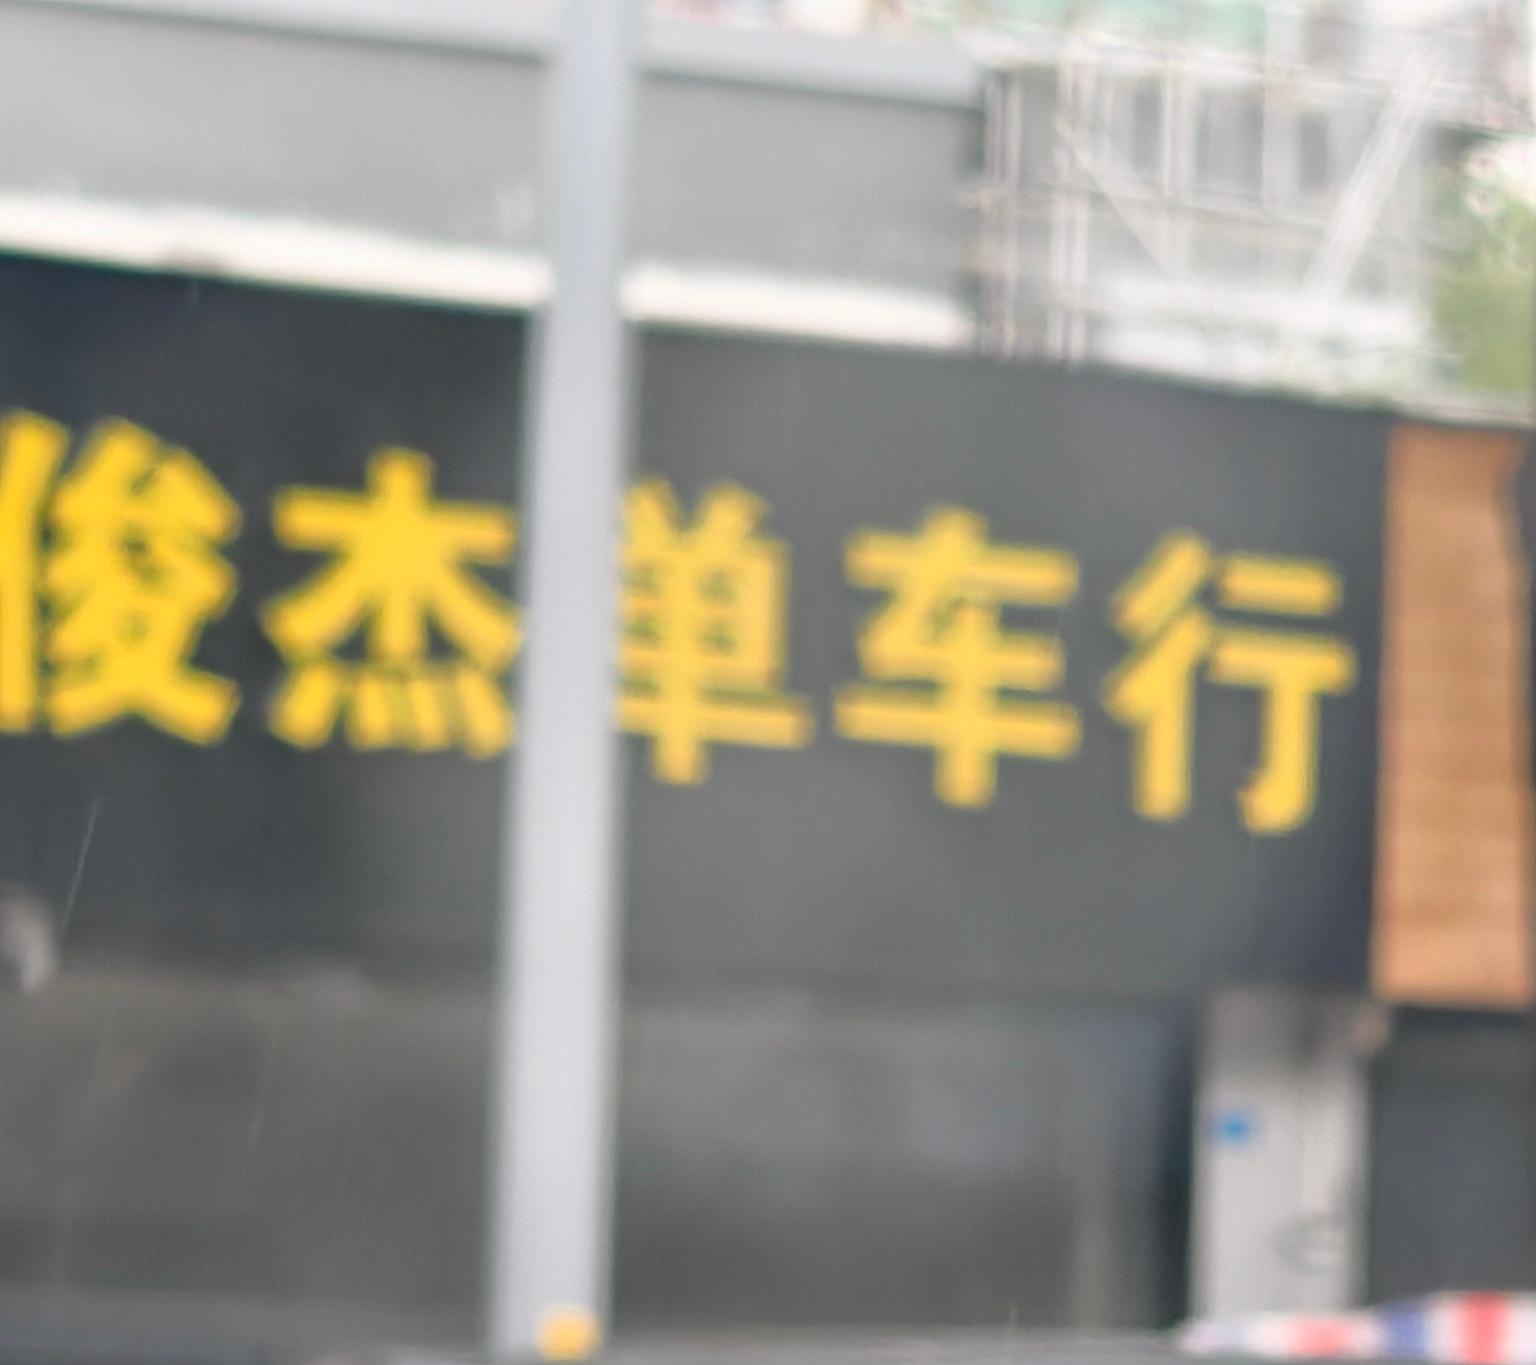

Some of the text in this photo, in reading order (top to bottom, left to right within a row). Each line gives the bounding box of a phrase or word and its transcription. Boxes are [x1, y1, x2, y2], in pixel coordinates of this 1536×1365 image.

[0, 413, 1356, 832] 俊杰单车行
